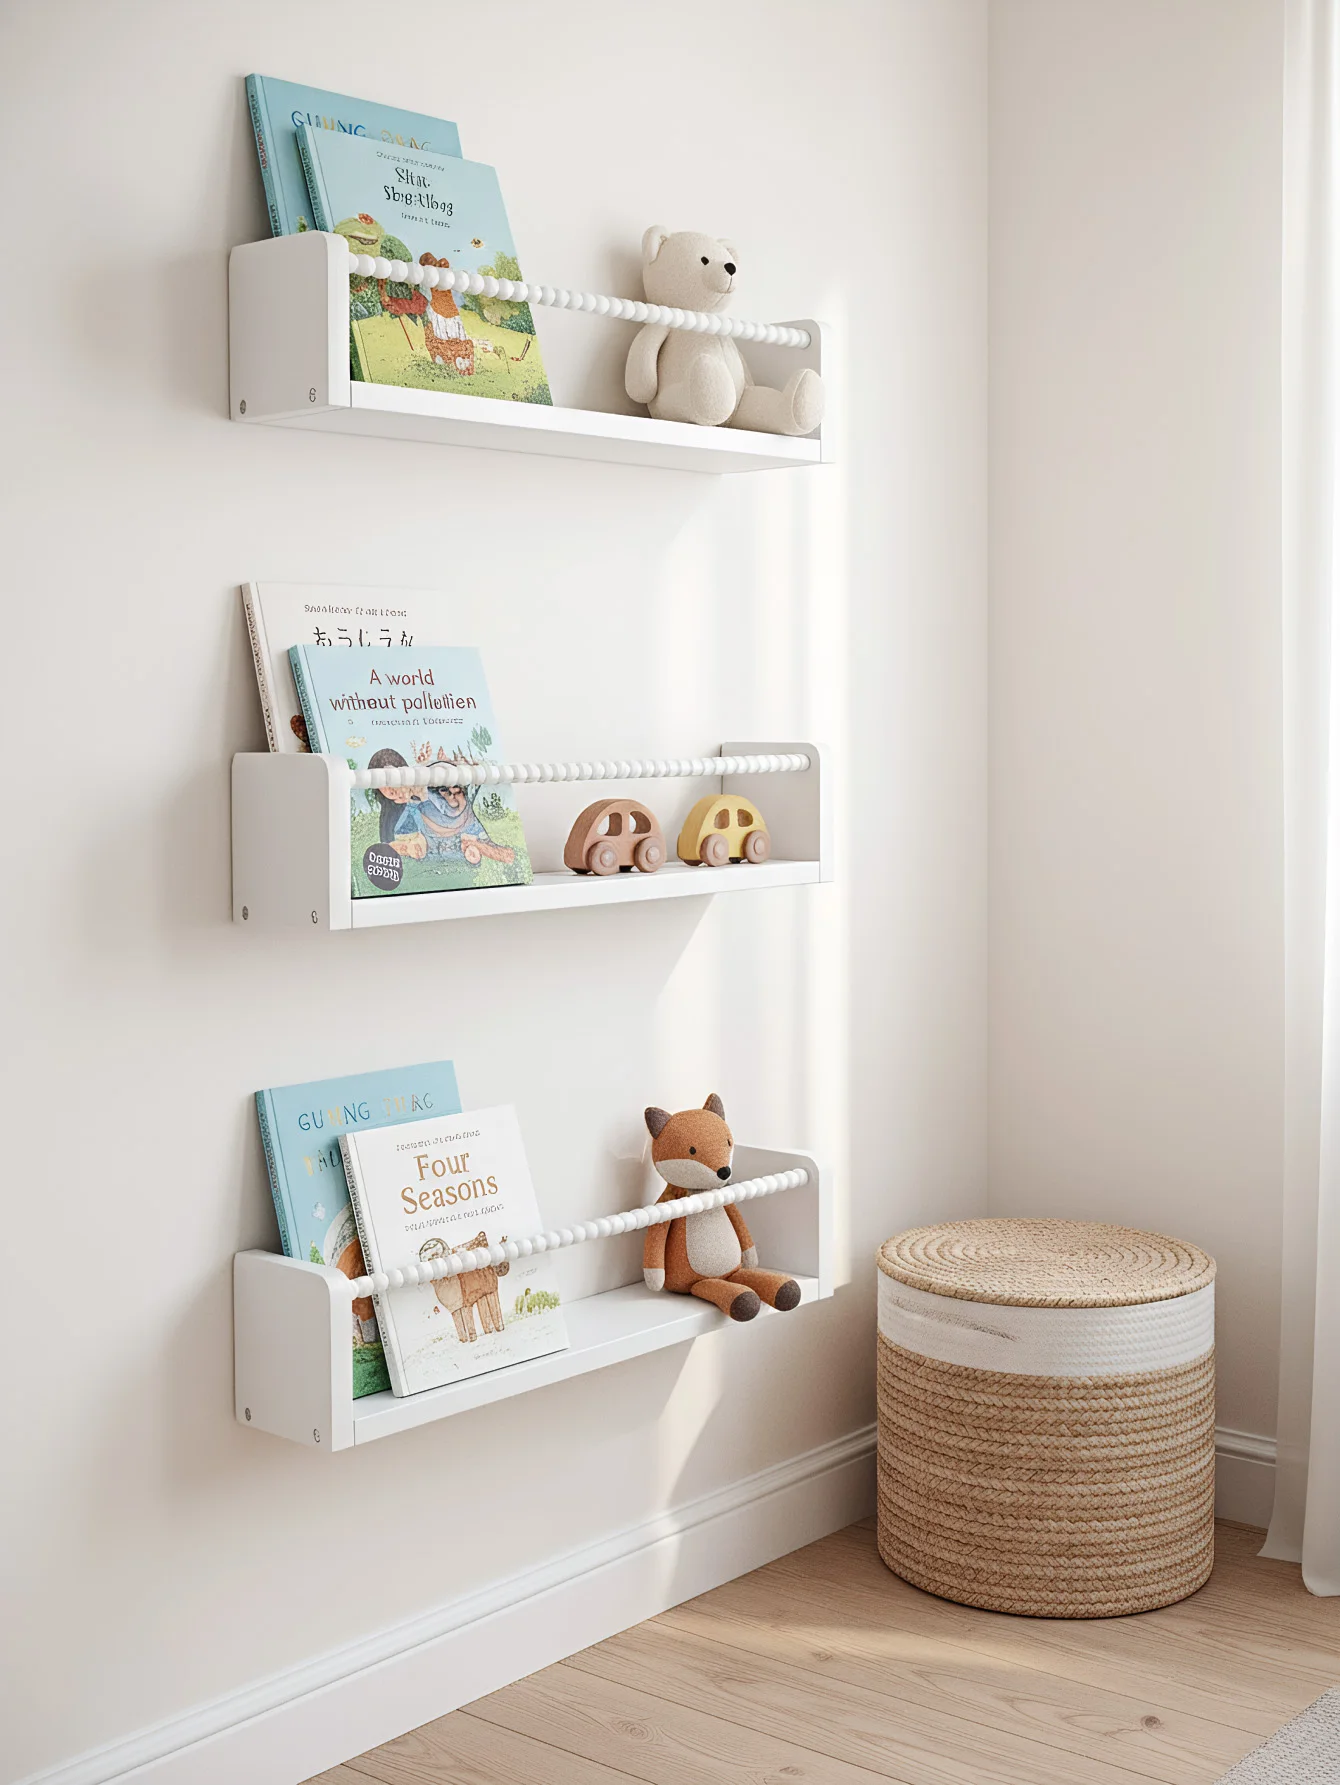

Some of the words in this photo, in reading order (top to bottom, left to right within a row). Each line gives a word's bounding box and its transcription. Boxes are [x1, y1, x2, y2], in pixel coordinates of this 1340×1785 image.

[370, 669, 382, 685] A
[385, 669, 435, 685] world
[413, 1153, 469, 1181] Four
[401, 1175, 498, 1214] Seasons
